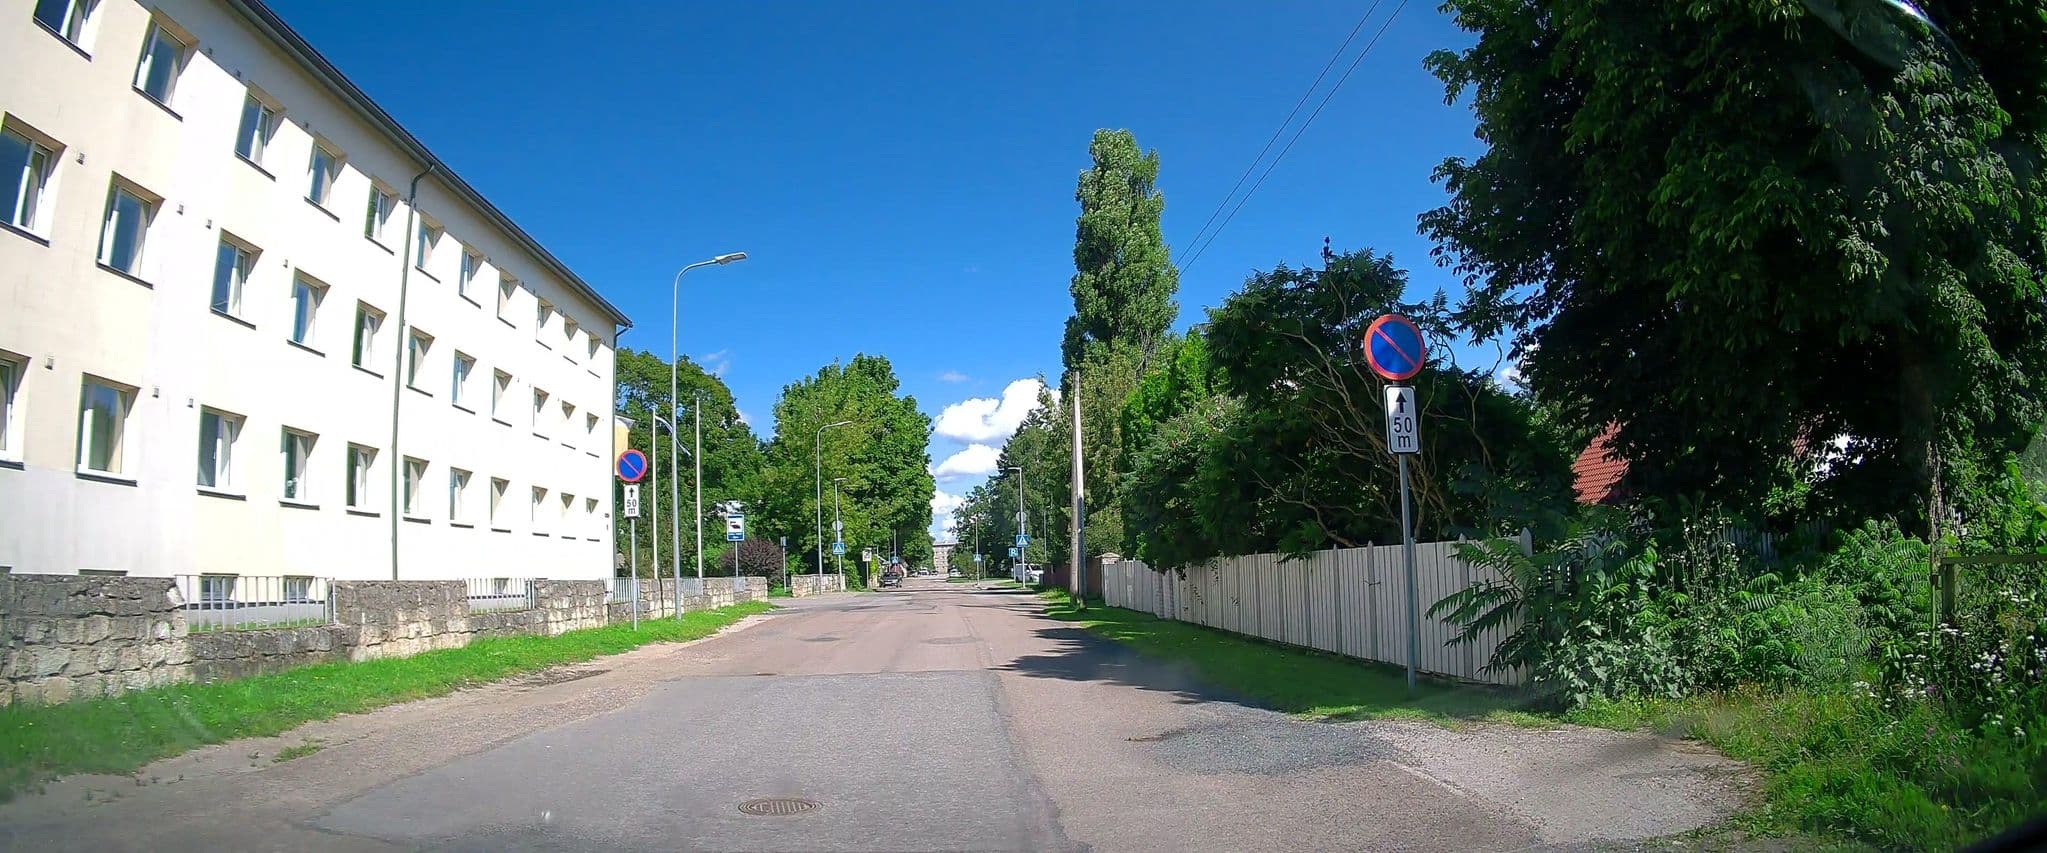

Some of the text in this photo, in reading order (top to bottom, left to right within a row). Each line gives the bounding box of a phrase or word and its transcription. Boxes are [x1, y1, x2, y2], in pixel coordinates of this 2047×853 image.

[1394, 417, 1412, 433] 50
[1398, 435, 1411, 448] m
[626, 499, 637, 507] 50
